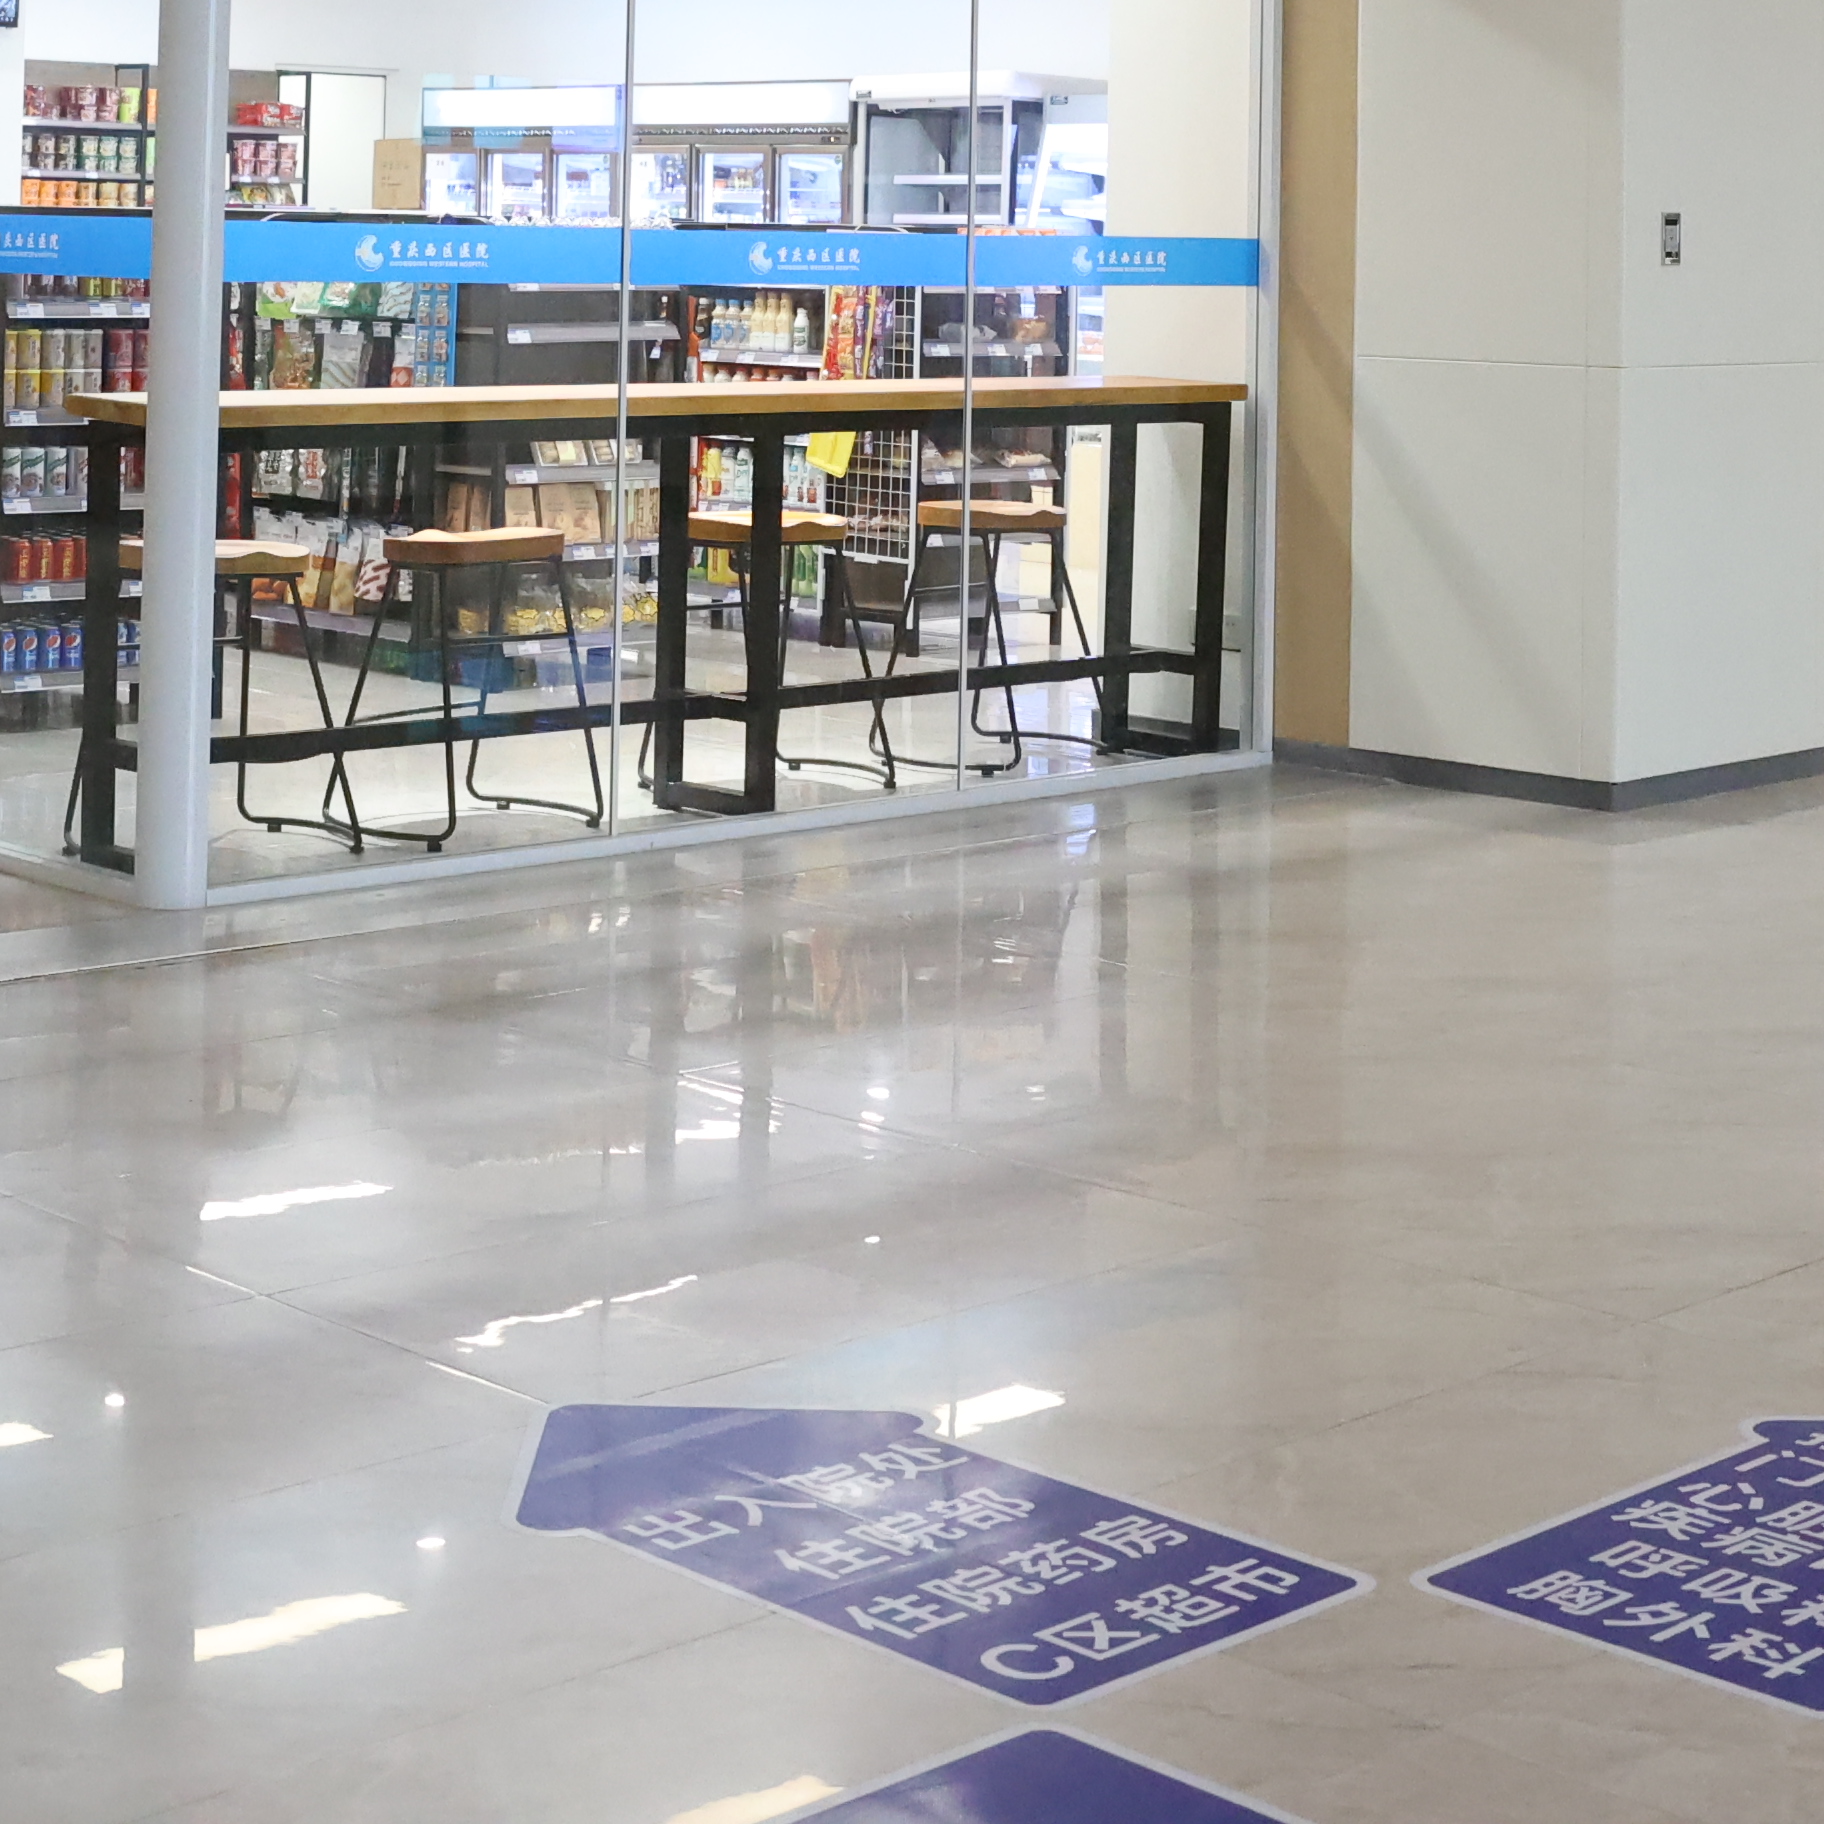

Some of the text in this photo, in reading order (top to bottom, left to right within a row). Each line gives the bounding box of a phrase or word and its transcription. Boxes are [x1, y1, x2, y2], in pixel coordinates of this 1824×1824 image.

[623, 1434, 968, 1554] 出入院处
[773, 1486, 1038, 1583] 住院部
[844, 1513, 1190, 1642] 住院药房
[979, 1555, 1303, 1683] C区超市
